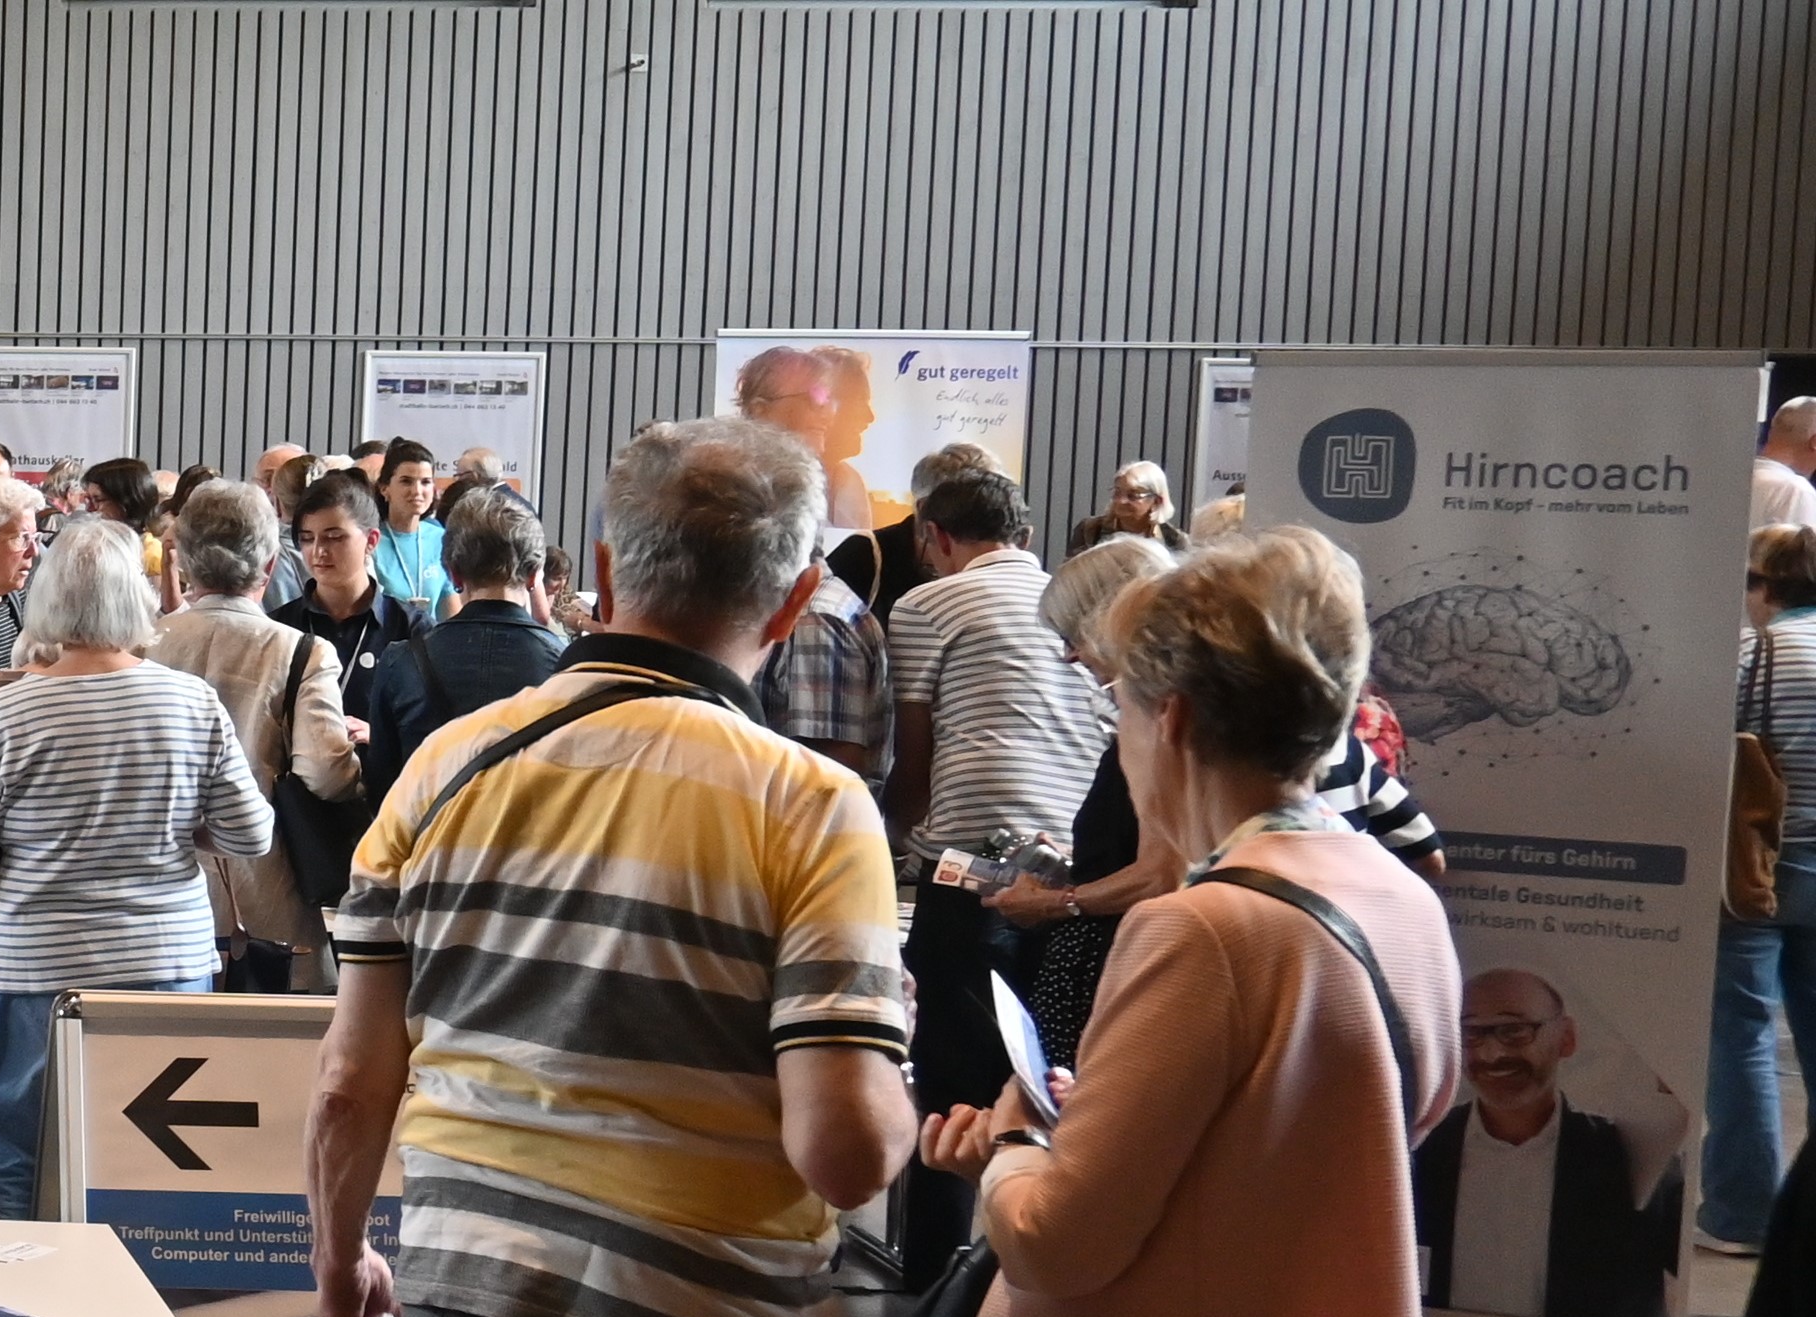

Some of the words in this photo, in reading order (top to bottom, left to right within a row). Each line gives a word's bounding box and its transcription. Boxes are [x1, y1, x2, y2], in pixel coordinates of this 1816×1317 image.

[917, 364, 946, 382] gut
[949, 364, 1019, 382] geregelt
[11, 453, 86, 467] athausker
[1212, 469, 1247, 482] Auss
[1444, 451, 1690, 492] Hirncoach
[1442, 497, 1467, 511] Fit
[1468, 497, 1490, 511] im
[1493, 498, 1534, 515] Kopf
[1547, 499, 1594, 514] mehr
[1636, 500, 1689, 516] Leben
[1444, 844, 1505, 861] enter
[1510, 845, 1557, 865] fürs
[1561, 848, 1638, 871] Gehirn
[1434, 883, 1510, 904] entale
[1515, 886, 1645, 913] Gesundheit
[1542, 915, 1556, 934] &
[1562, 916, 1681, 943] wohltuend
[233, 1208, 313, 1228] Freiwillige
[118, 1225, 200, 1246] Treffpunkt
[203, 1227, 235, 1243] und
[238, 1229, 313, 1245] Unterstüt
[151, 1246, 231, 1264] Computer
[234, 1247, 265, 1263] und
[268, 1249, 312, 1263] ande
